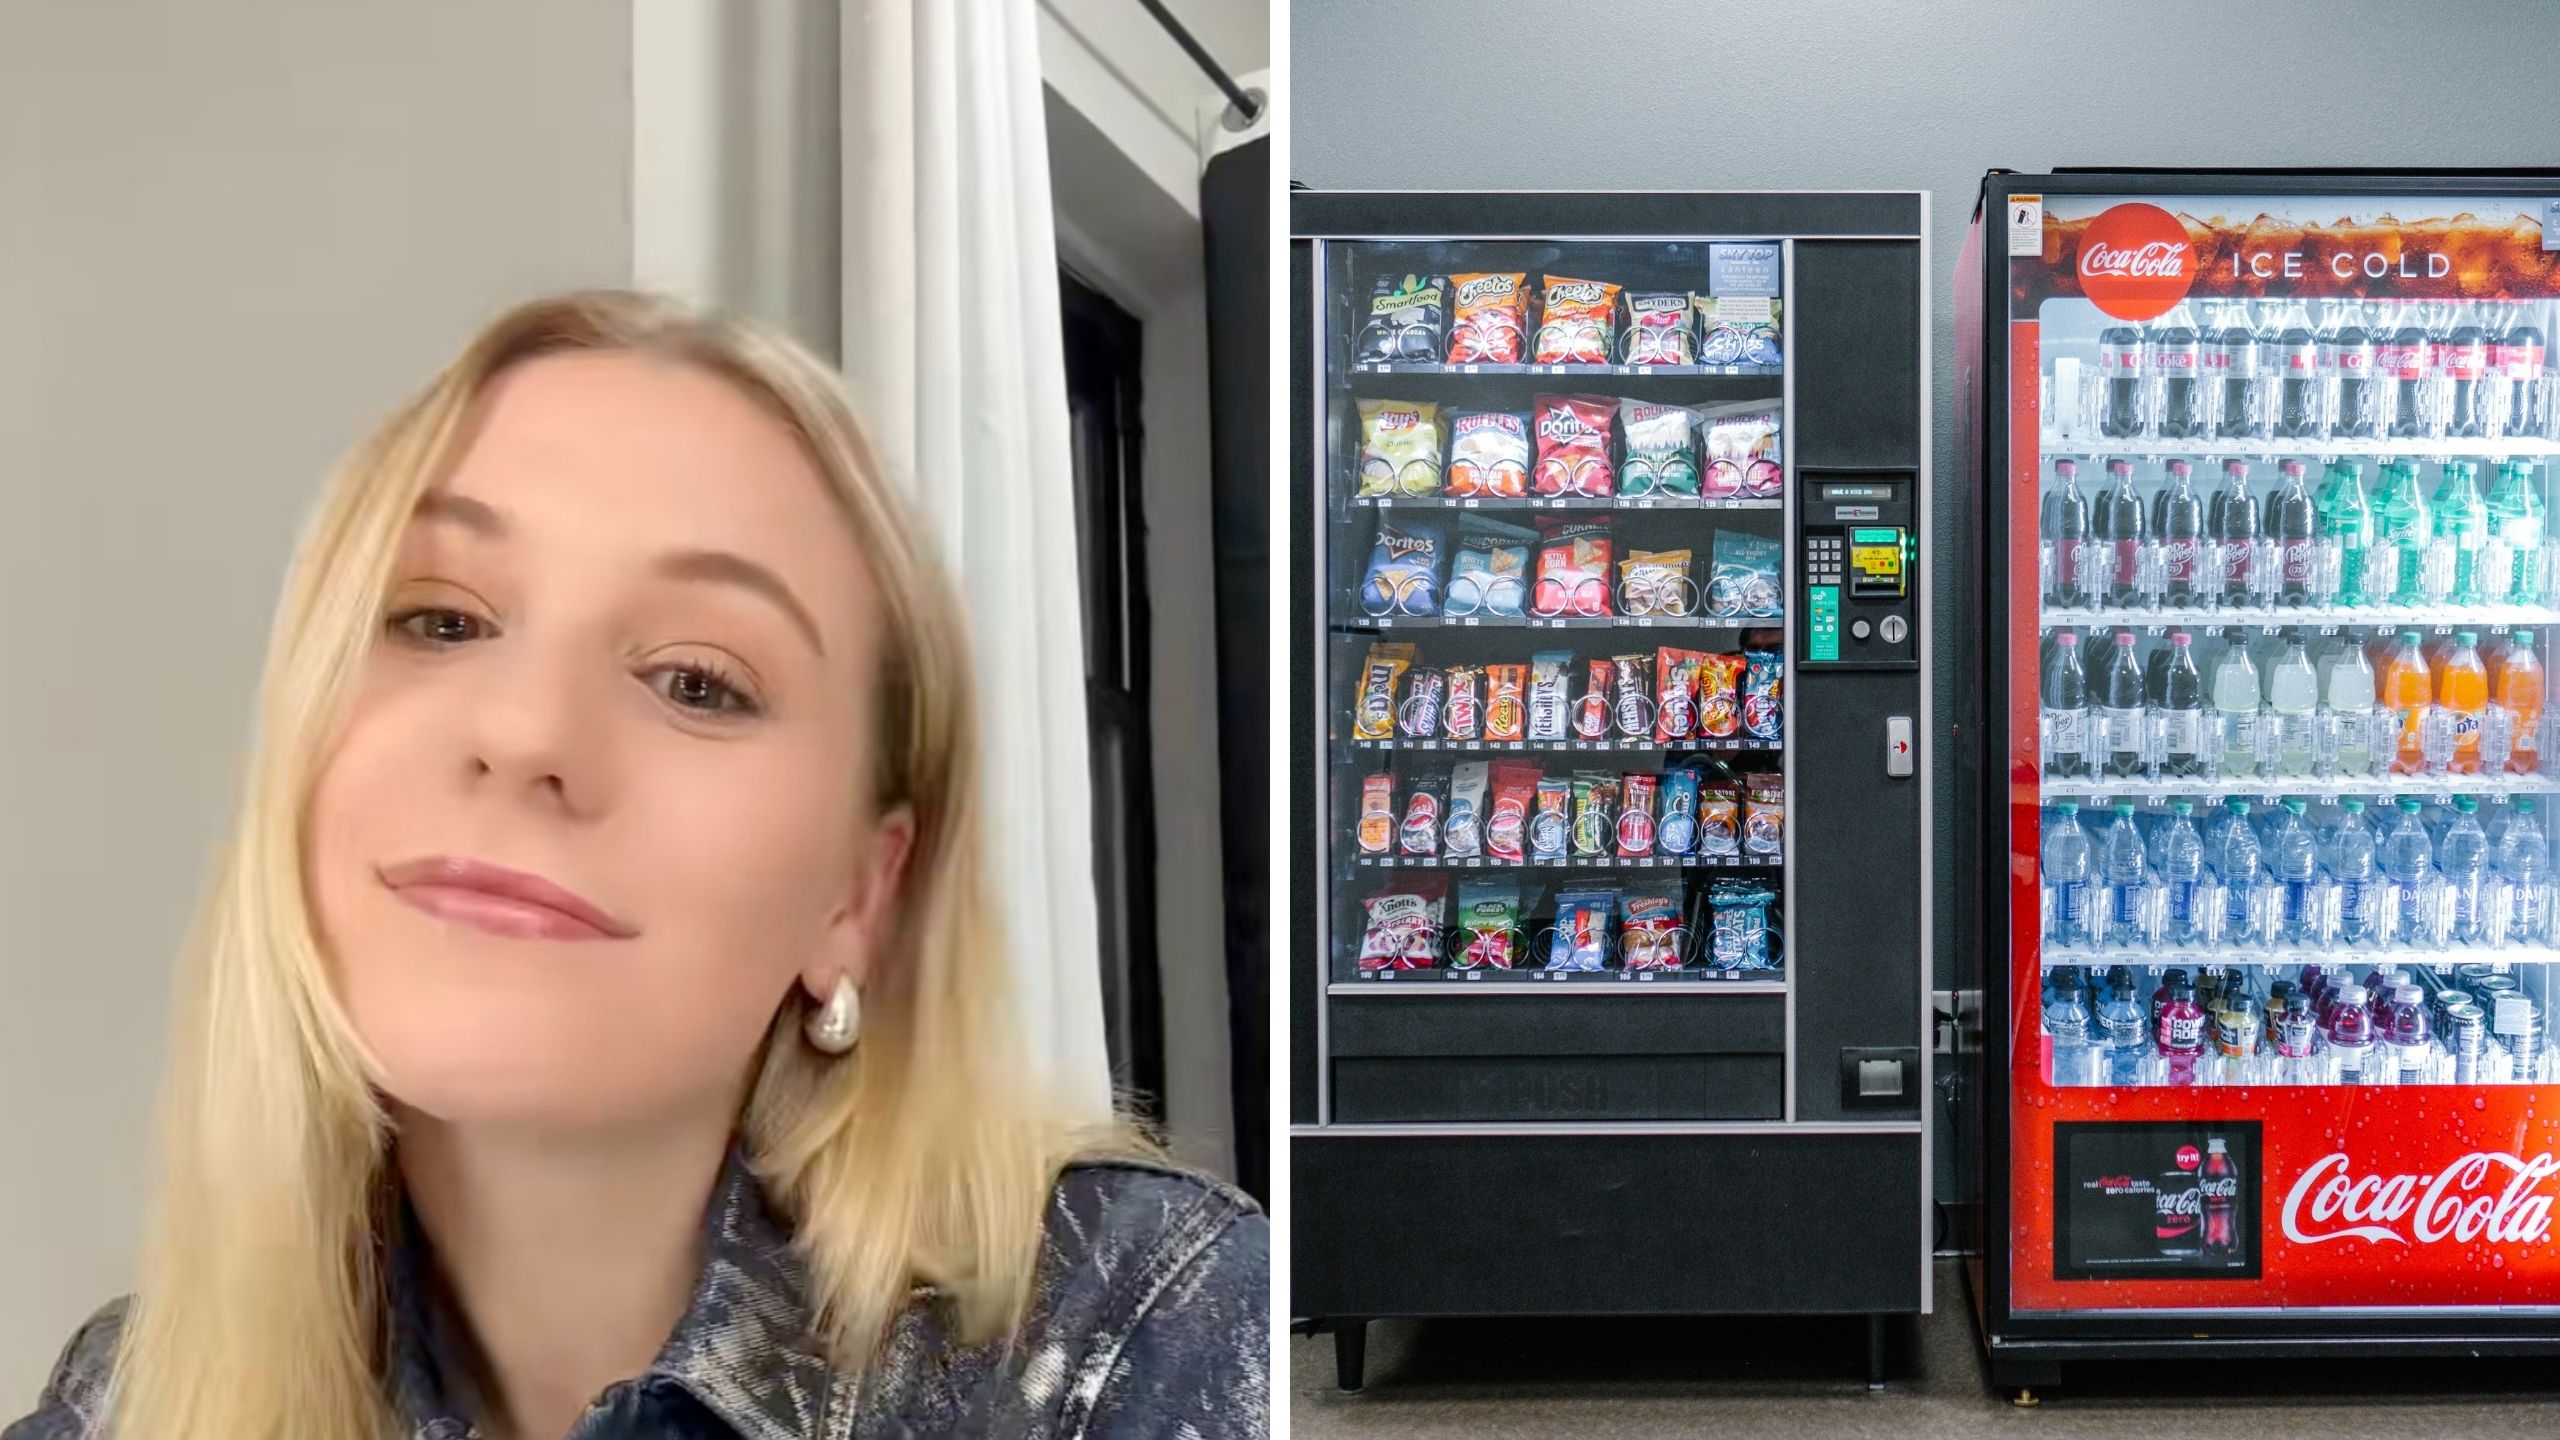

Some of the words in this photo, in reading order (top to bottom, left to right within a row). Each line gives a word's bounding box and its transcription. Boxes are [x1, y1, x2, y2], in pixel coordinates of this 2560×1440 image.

[1720, 248, 1774, 260] SKYTOP
[2080, 241, 2188, 277] Coca-Cola
[2233, 252, 2302, 278] ICE
[2332, 252, 2450, 279] COLD
[1459, 276, 1514, 306] Cheetos
[1546, 283, 1604, 306] Cheetos
[1376, 293, 1438, 310] Smartfood
[2157, 354, 2187, 367] Coke
[1380, 412, 1418, 431] Lay's
[1456, 413, 1520, 435] RUFFLES
[2227, 544, 2239, 552] Dr
[1461, 555, 1486, 564] WHITE
[1544, 560, 1566, 568] CORN
[2456, 717, 2479, 734] nta
[2176, 1154, 2190, 1162] try
[2190, 1154, 2200, 1162] it!
[2084, 1180, 2098, 1188] real
[2131, 1179, 2150, 1187] taste
[2106, 1187, 2124, 1195] zero
[2124, 1186, 2156, 1194] calories
[2280, 1152, 2560, 1245] Coca-Cola
[2166, 1214, 2190, 1224] zero
